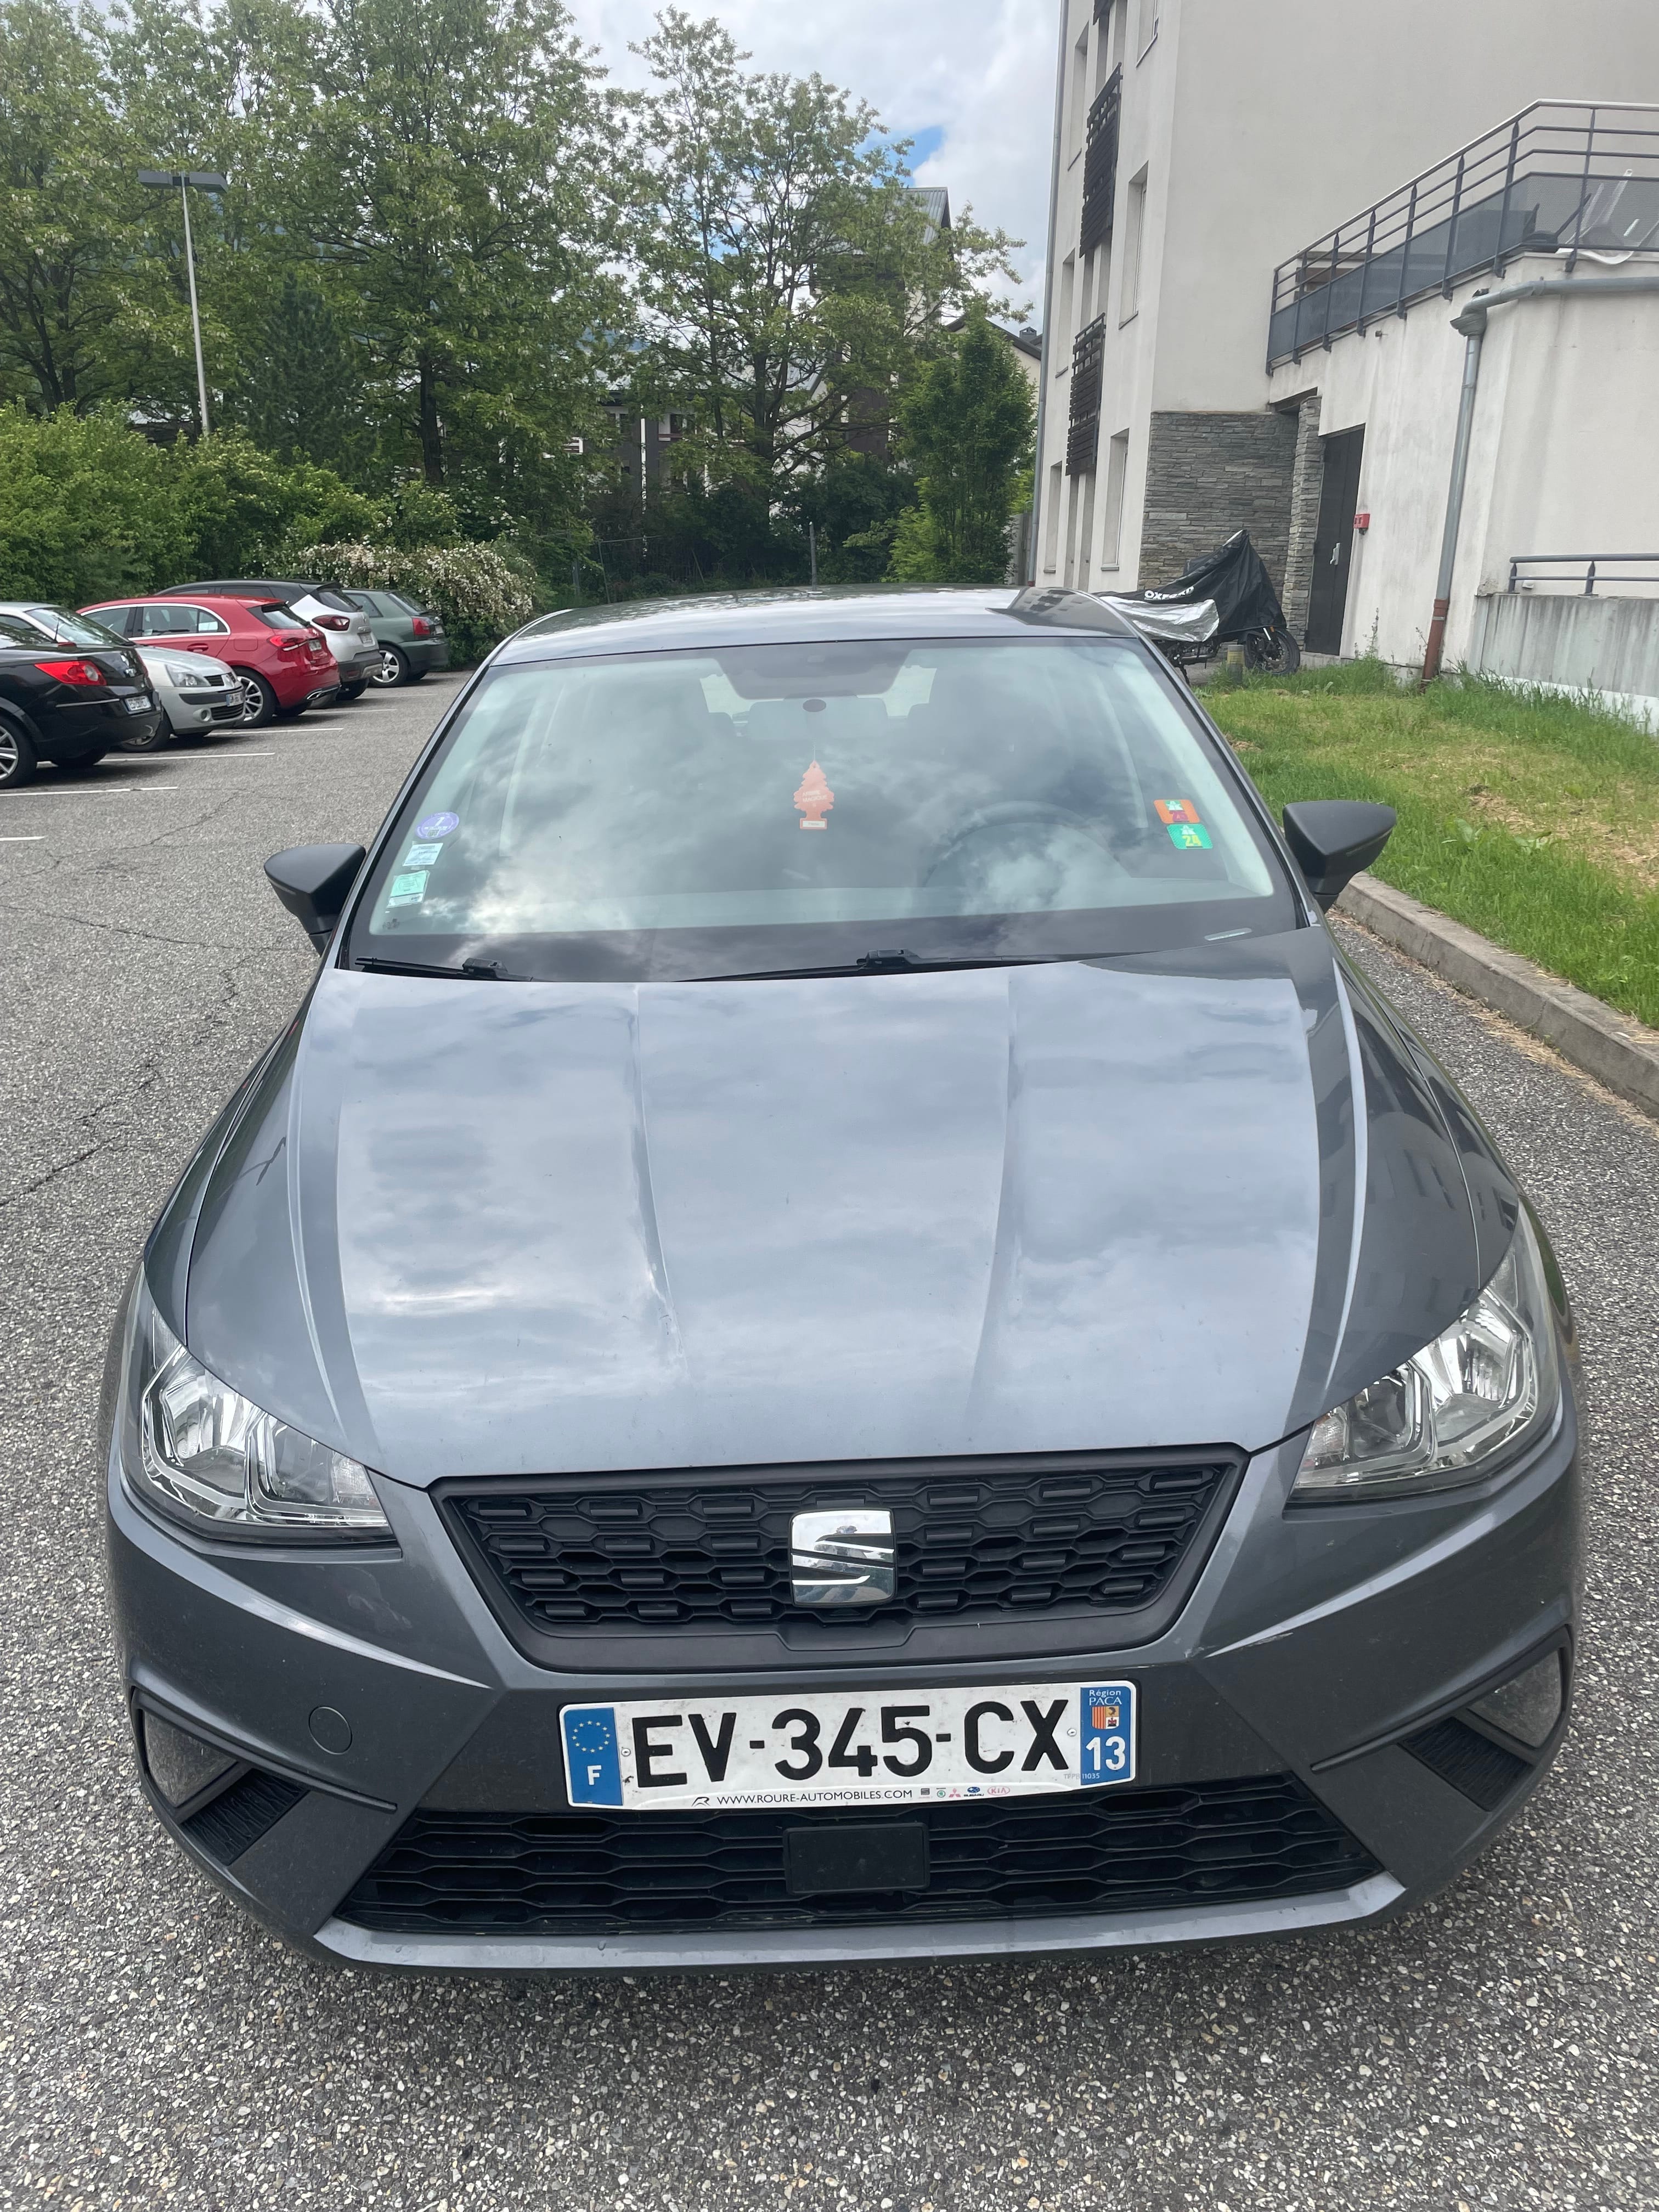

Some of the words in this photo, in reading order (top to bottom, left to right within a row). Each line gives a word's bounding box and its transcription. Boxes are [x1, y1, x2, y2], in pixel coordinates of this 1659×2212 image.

[1144, 586, 1194, 600] OXFORD
[1182, 834, 1203, 847] 24
[1089, 1689, 1121, 1698] Région
[1089, 1697, 1122, 1706] PACA
[633, 1700, 1068, 1788] EV-345-CX
[1086, 1736, 1126, 1771] 13
[587, 1765, 602, 1785] F
[716, 1790, 912, 1805] WWW.ROURE-AUTOMOBILES.COM
